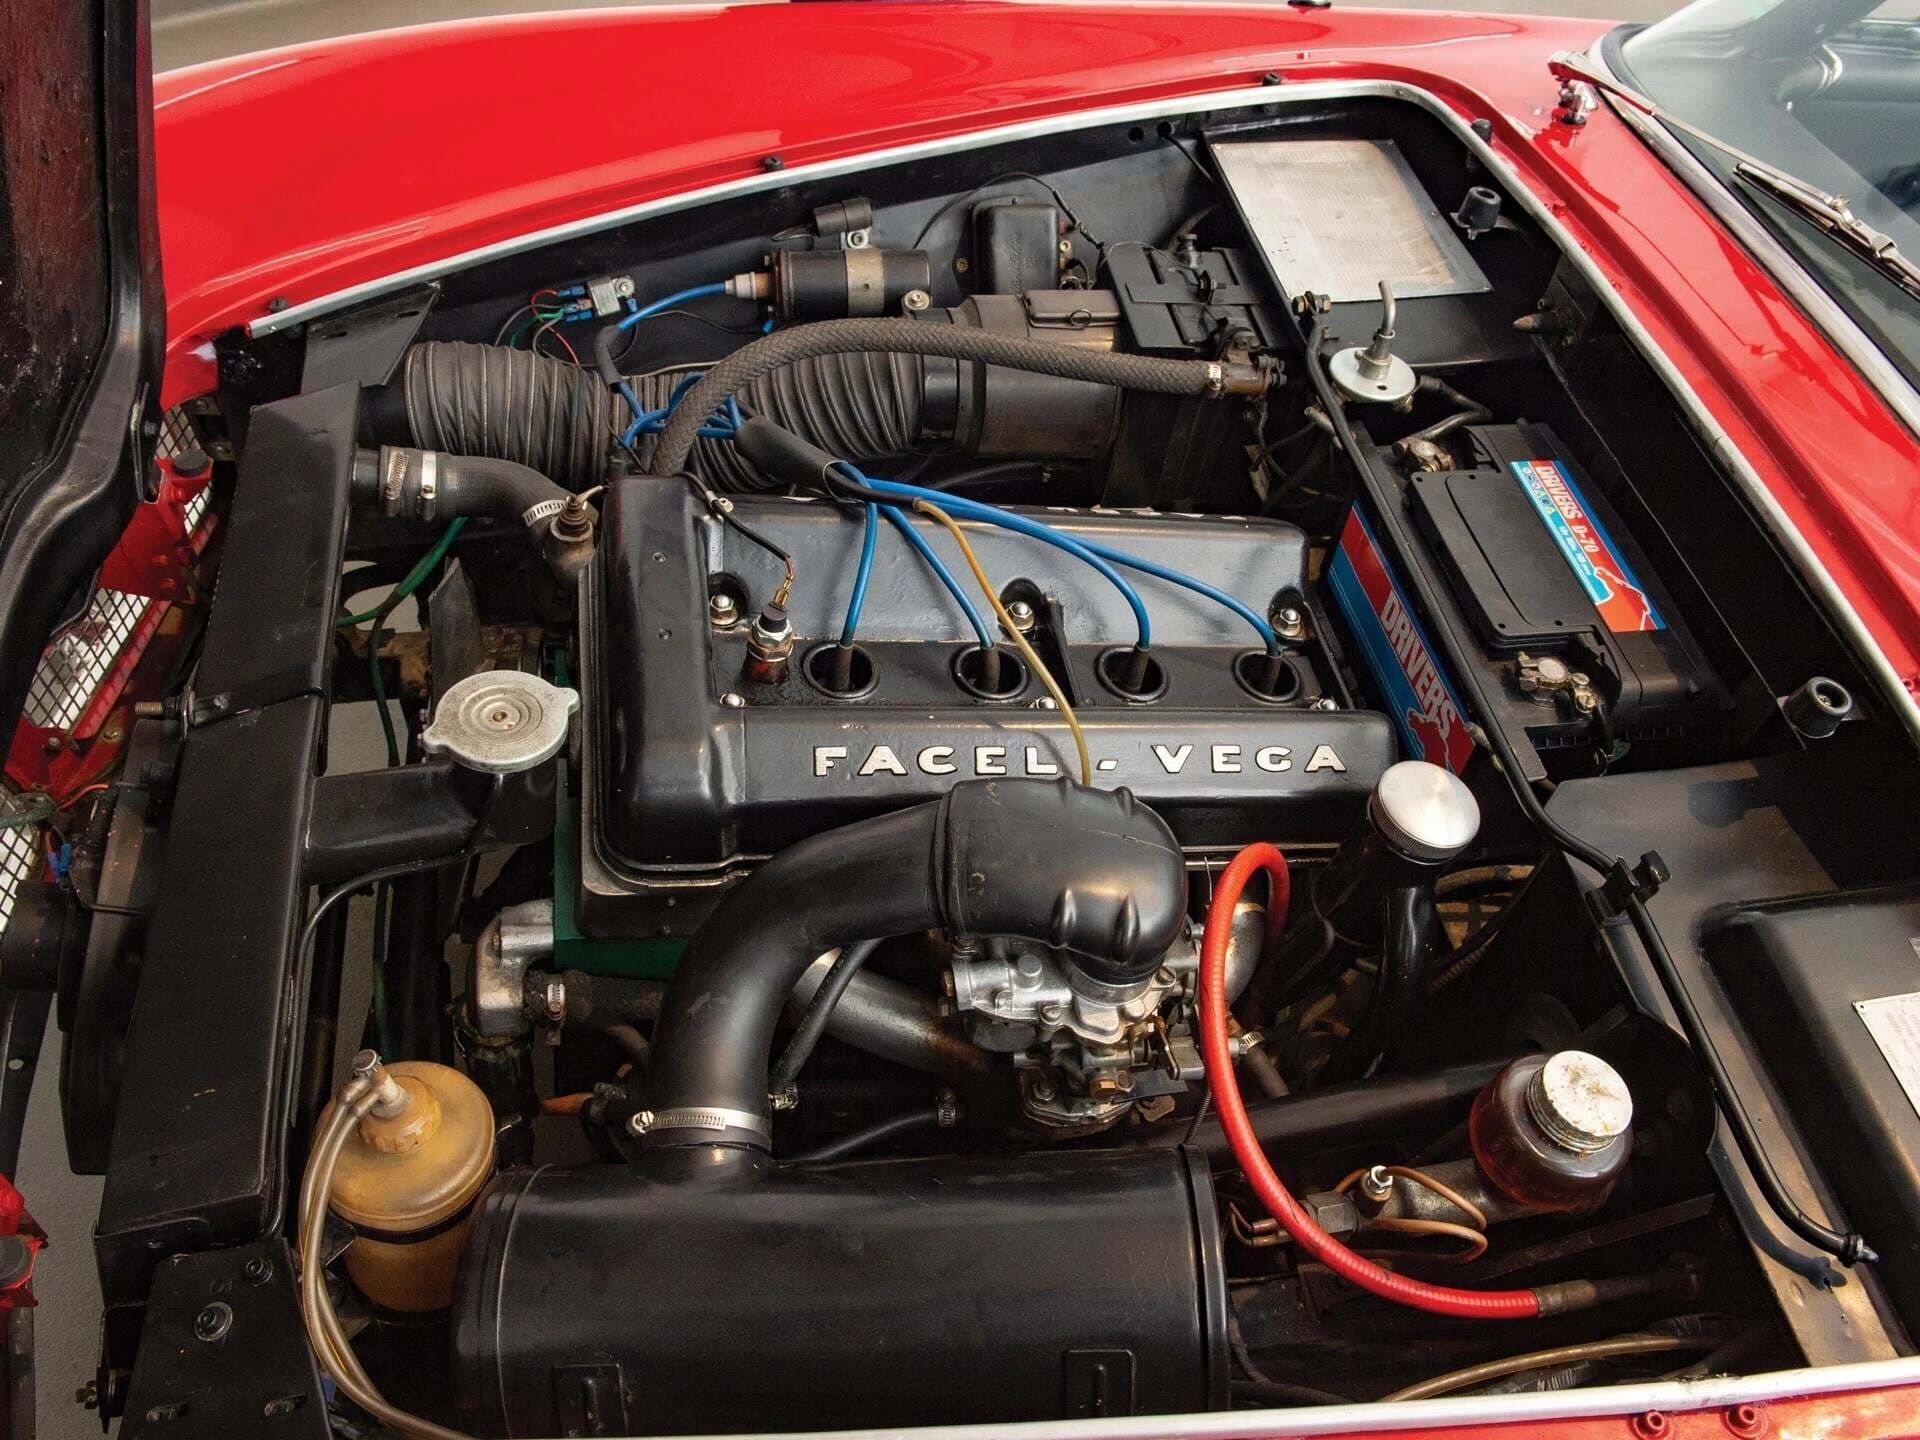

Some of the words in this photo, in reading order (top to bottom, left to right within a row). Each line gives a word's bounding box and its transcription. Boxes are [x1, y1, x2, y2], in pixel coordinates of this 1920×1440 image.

[1535, 466, 1583, 520] DRIVERS
[1571, 525, 1600, 553] D-70
[1381, 592, 1456, 738] DRIVERS
[812, 744, 1059, 777] FACEL
[1152, 743, 1348, 775] VEGA
